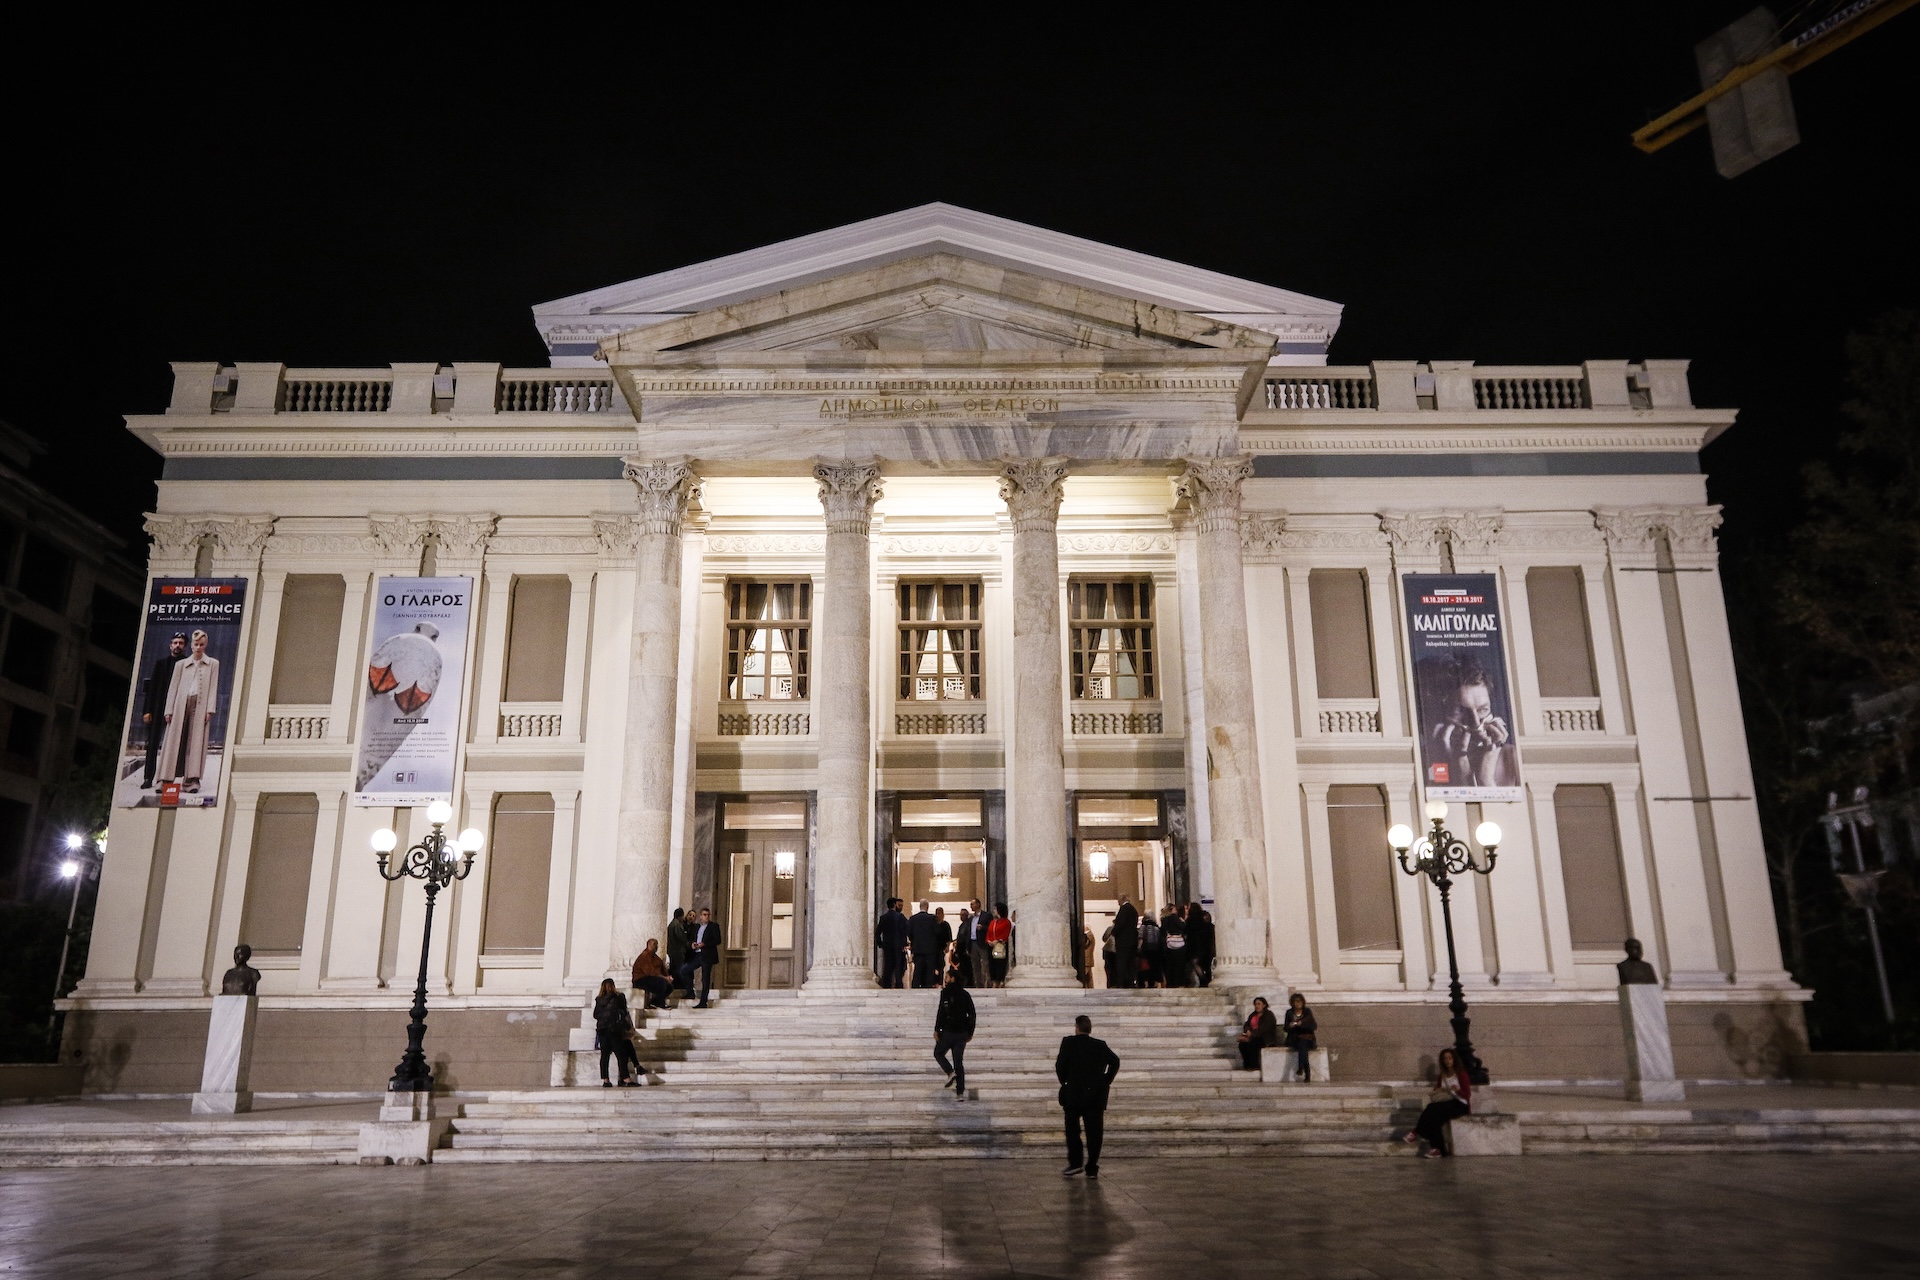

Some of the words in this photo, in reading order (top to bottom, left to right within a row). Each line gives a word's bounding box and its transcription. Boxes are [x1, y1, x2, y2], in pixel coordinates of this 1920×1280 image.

[819, 398, 939, 412] ΔΗΜΟΤΙΚΟΝ
[963, 398, 1059, 412] ΘΕΑΤΡΟΝ
[183, 586, 195, 594] ΣΕΠ
[201, 586, 208, 594] 15
[208, 586, 221, 594] ΟΚΤ
[384, 594, 396, 606] Ο
[401, 594, 463, 606] ΓΛΑΡΟΣ
[149, 604, 188, 614] PETIT
[192, 604, 241, 614] PRINCE
[1413, 614, 1498, 631] ΚΑΛΙΓΟΥΛΑΣ
